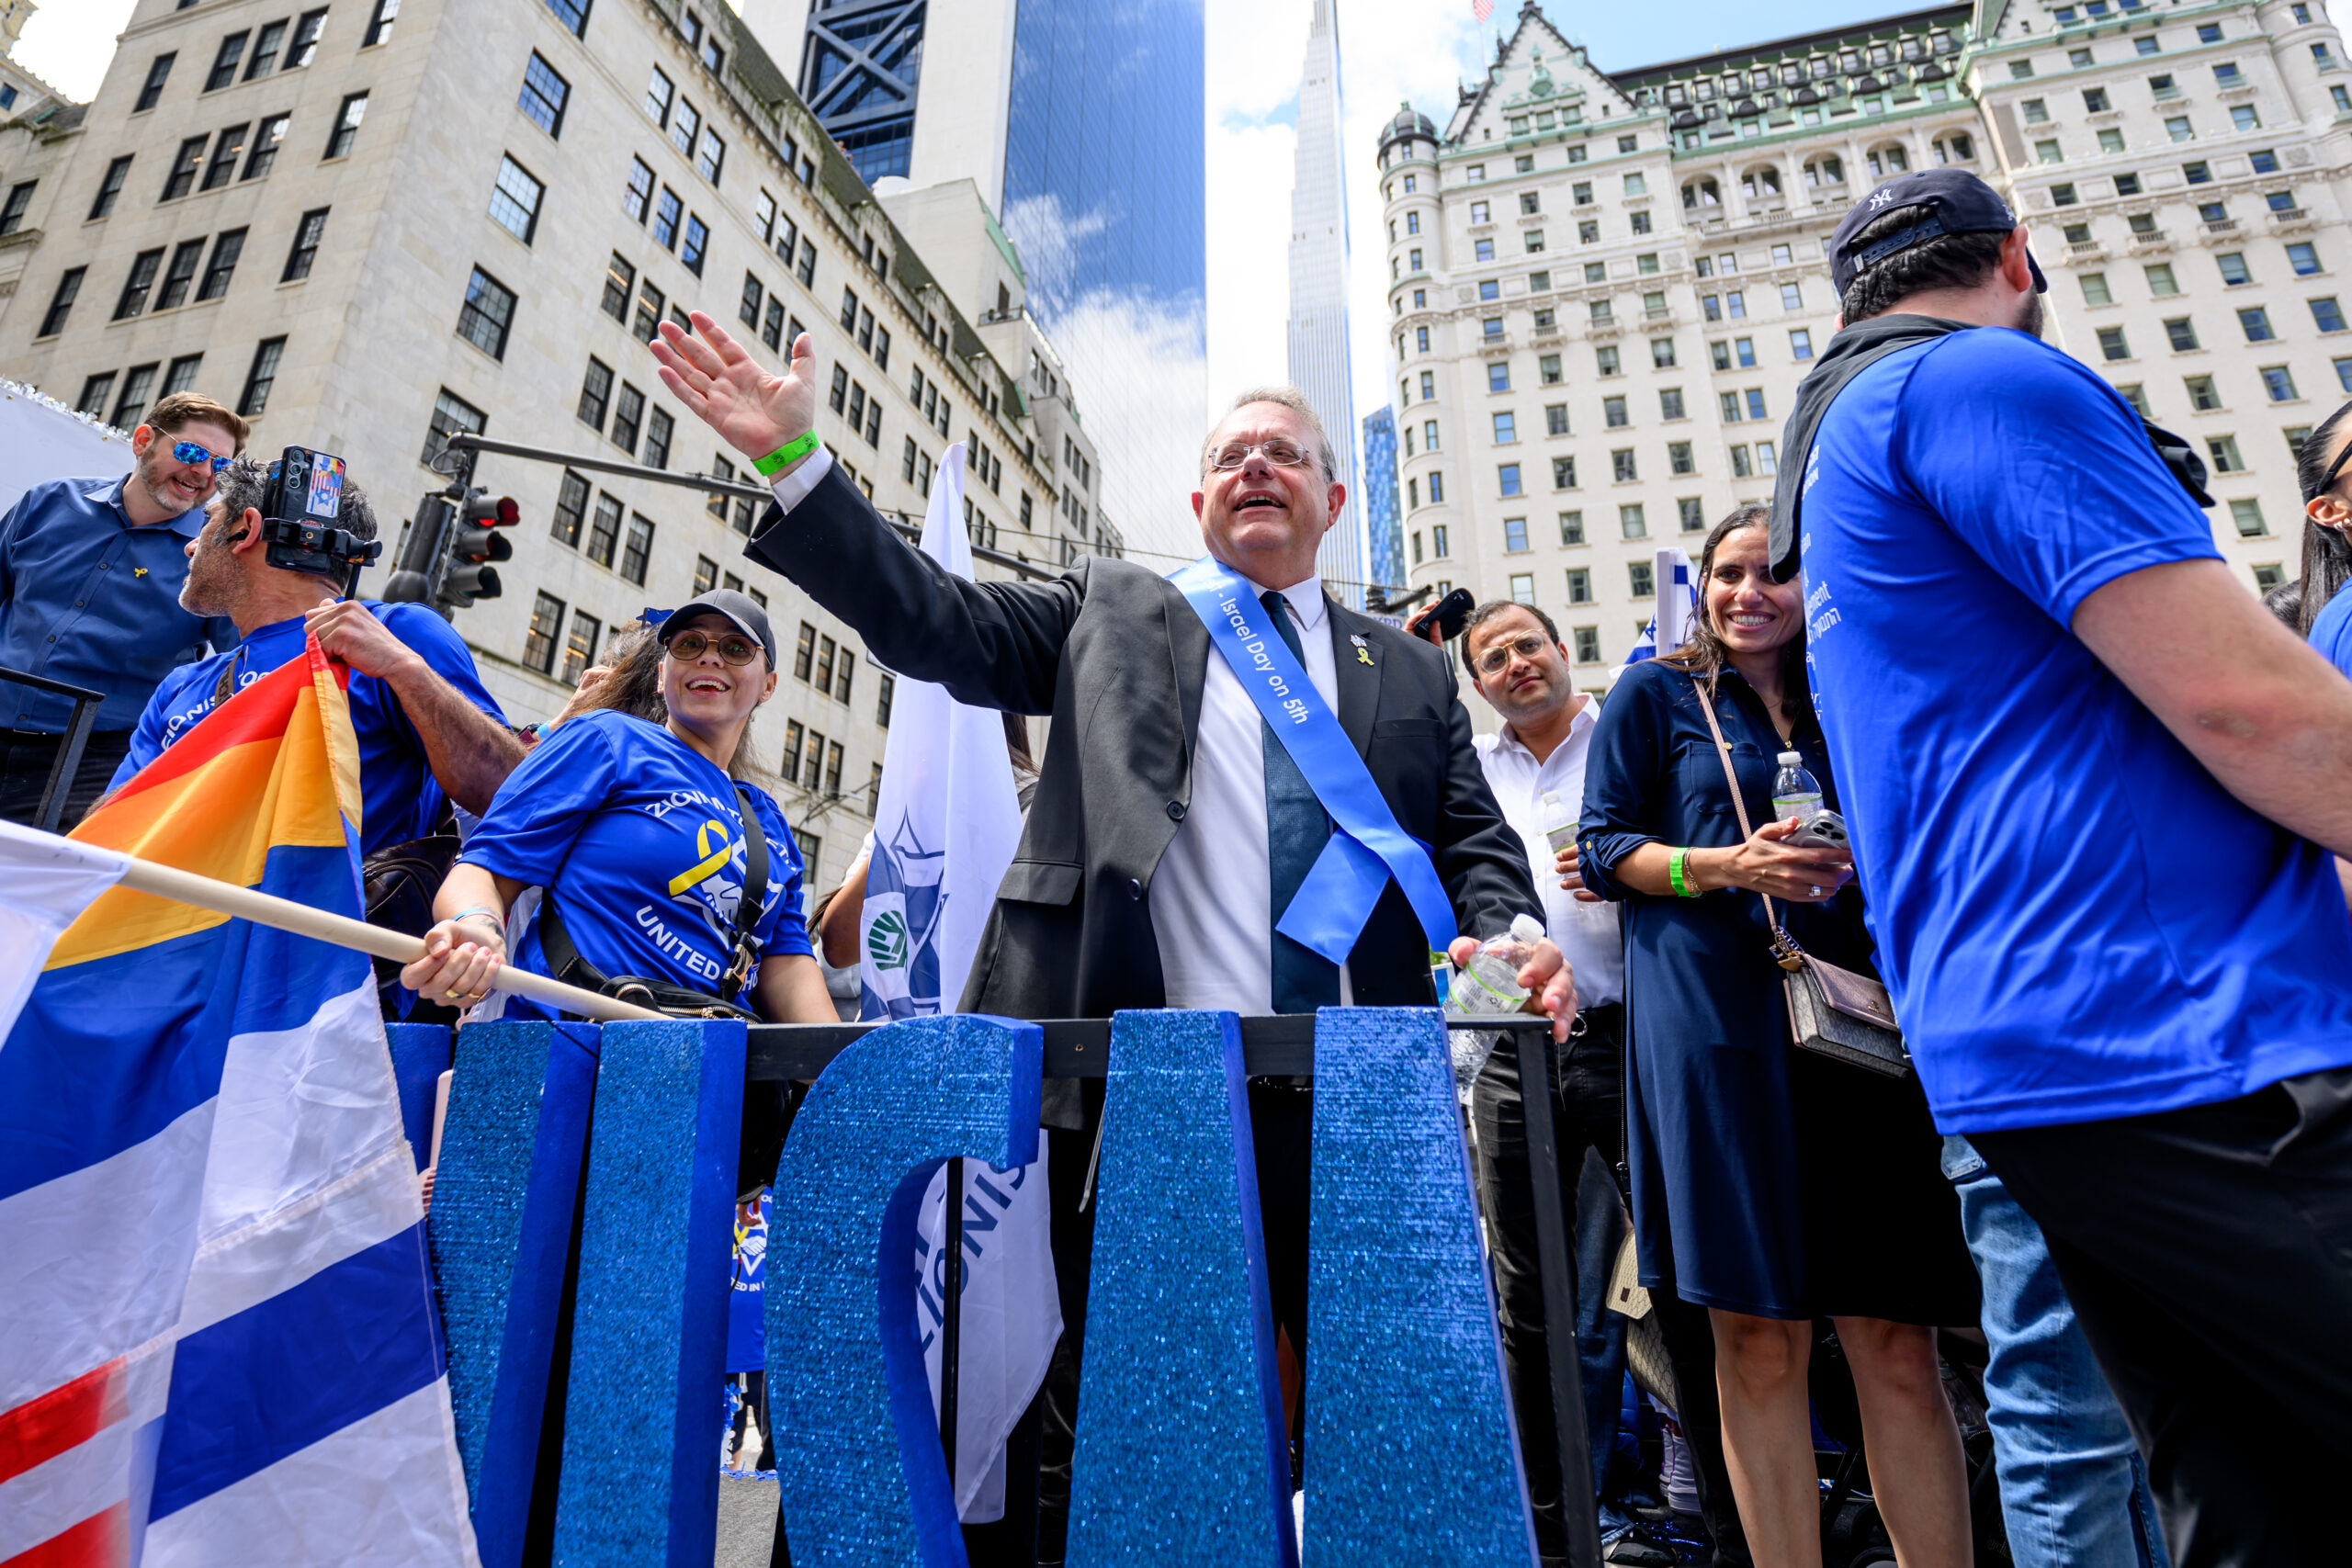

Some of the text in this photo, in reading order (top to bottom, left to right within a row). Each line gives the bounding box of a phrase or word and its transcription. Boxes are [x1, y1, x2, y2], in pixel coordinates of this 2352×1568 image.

[1220, 597, 1258, 641] Israel
[1246, 640, 1275, 671] Day
[1268, 675, 1290, 697] on
[1283, 698, 1309, 725] 5th
[636, 905, 720, 981] UNITED
